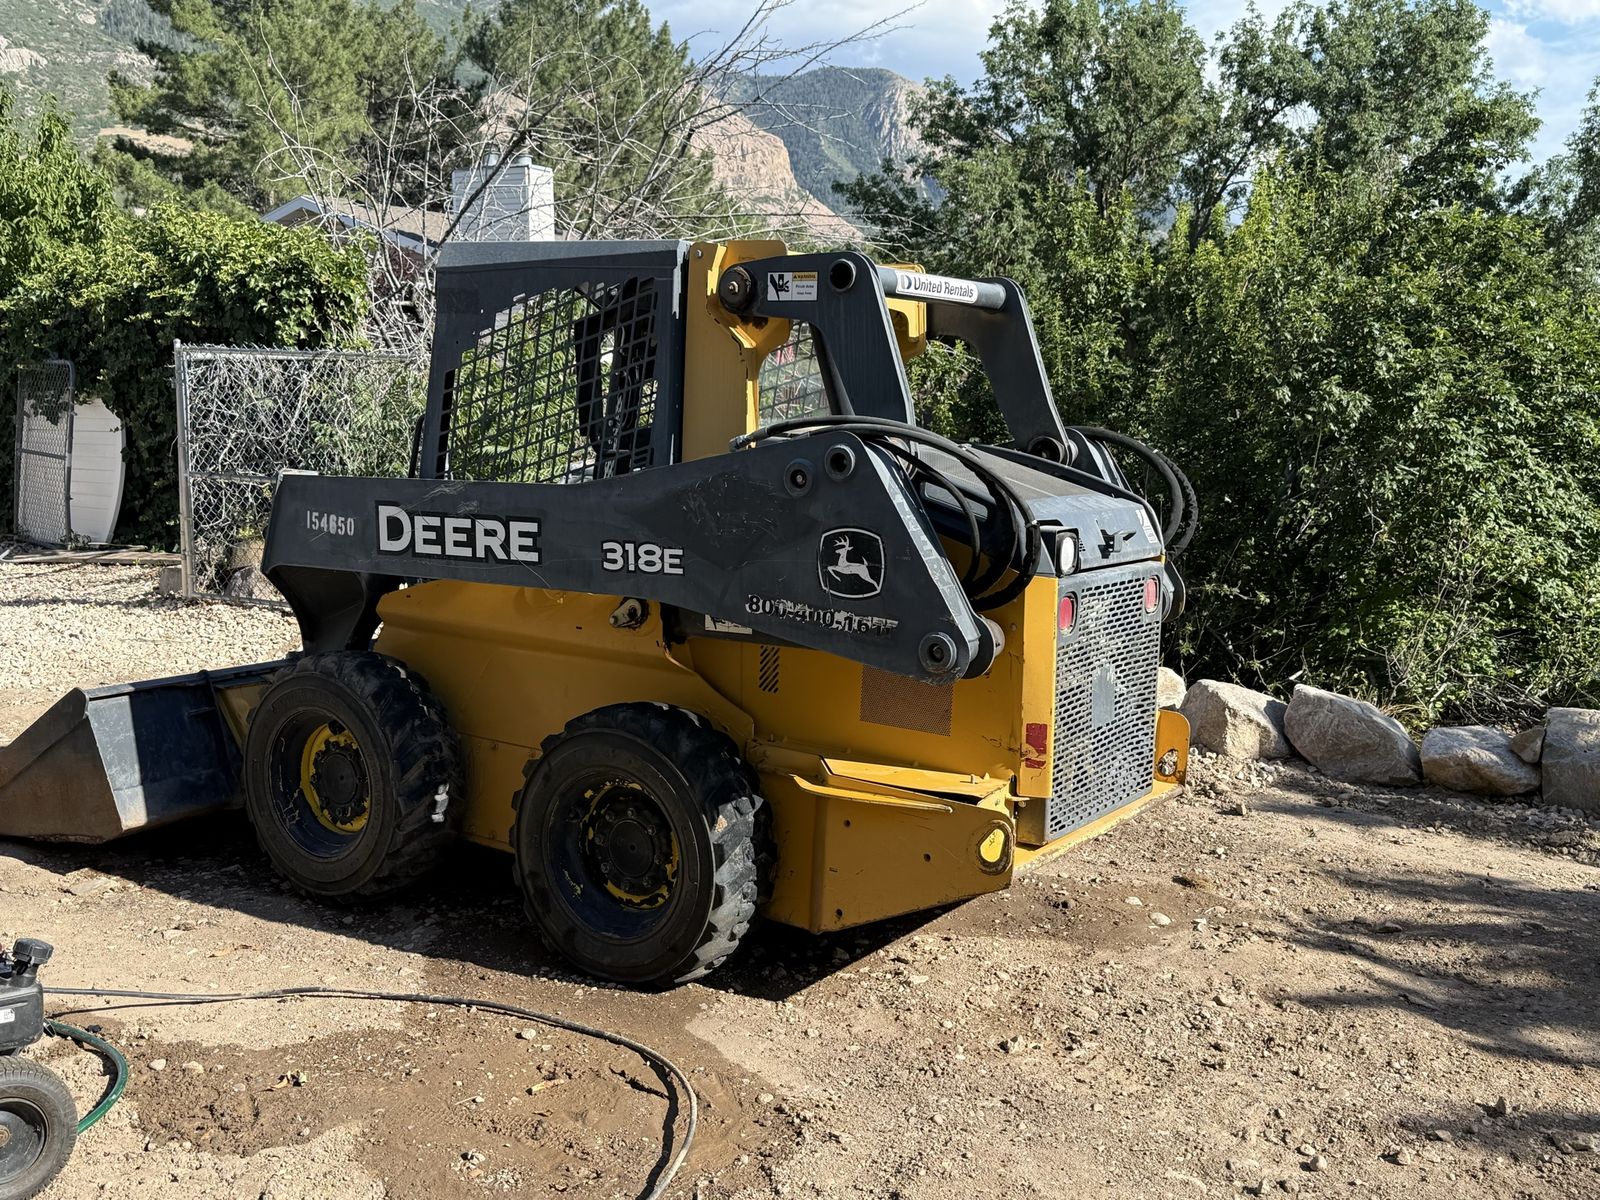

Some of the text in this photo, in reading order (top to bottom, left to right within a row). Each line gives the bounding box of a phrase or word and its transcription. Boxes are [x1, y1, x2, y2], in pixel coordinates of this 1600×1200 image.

[913, 277, 974, 298] United Rentals
[378, 505, 539, 562] DEERE
[602, 542, 684, 575] 318E
